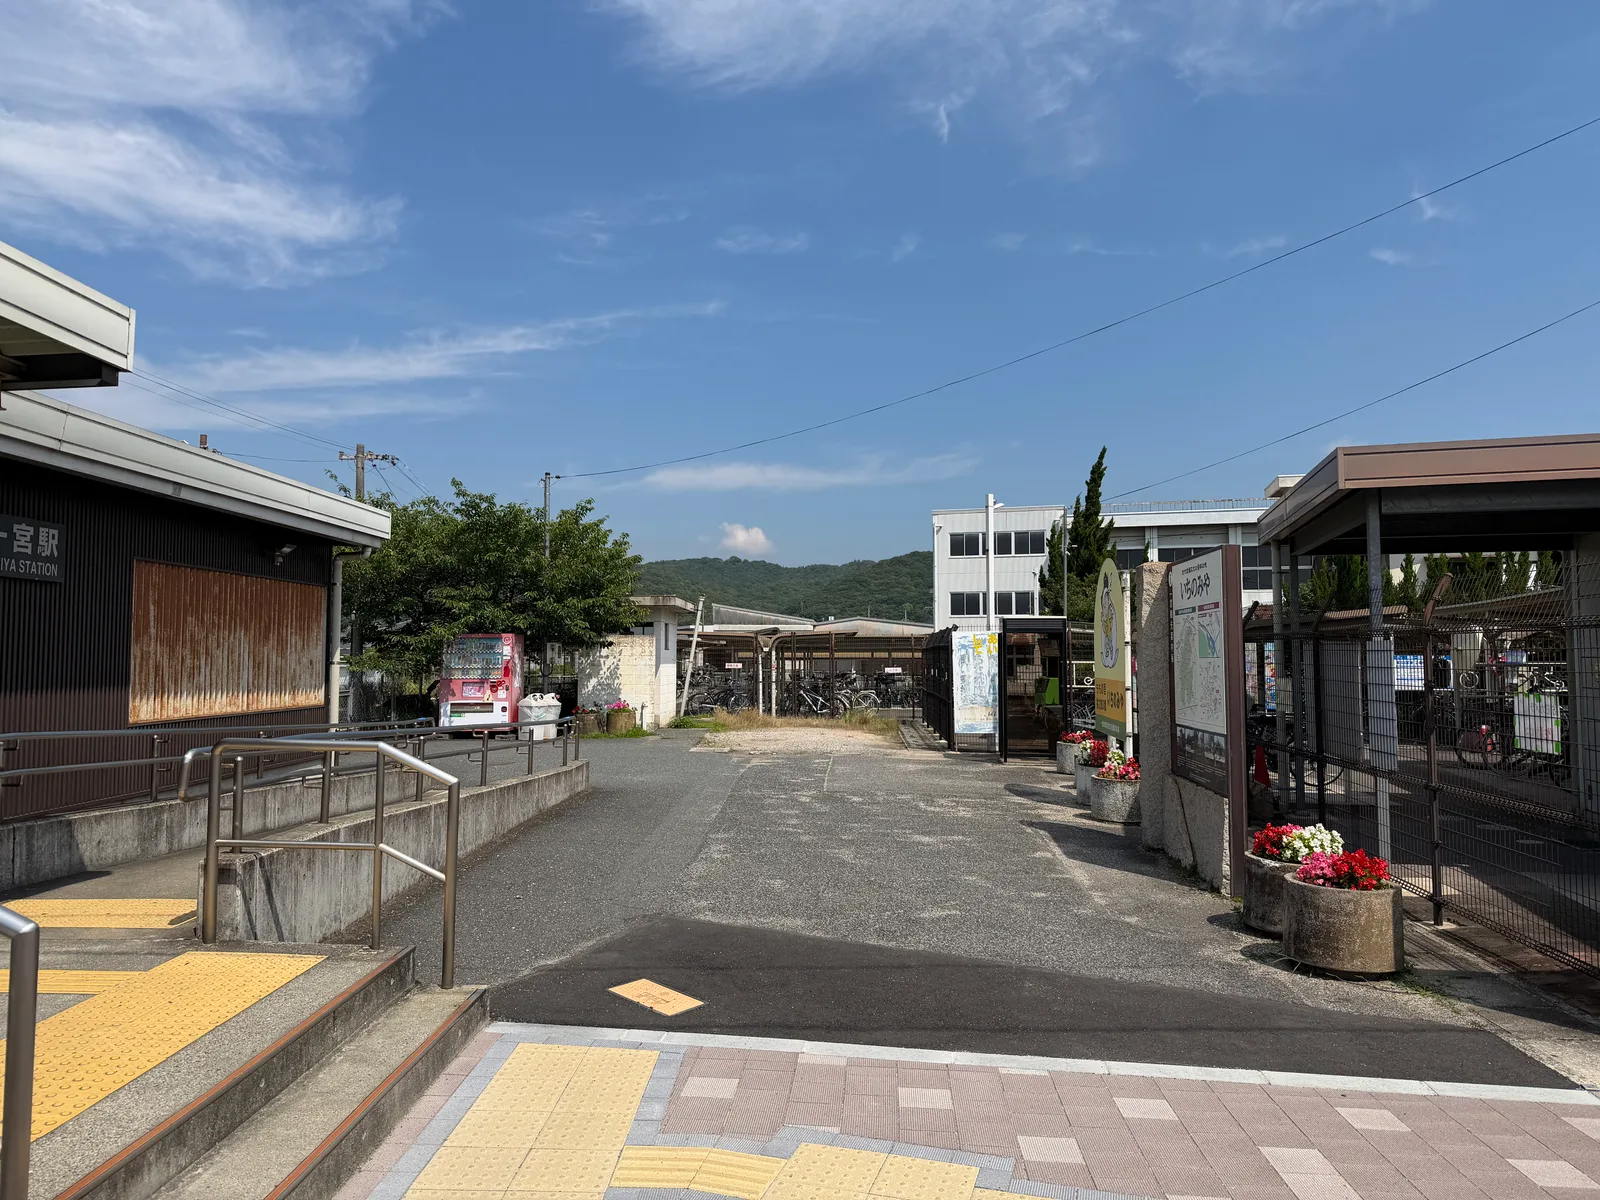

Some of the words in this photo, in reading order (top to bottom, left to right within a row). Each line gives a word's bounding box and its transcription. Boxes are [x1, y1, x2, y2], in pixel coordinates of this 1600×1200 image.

[18, 559, 58, 577] STATION
[1180, 572, 1211, 600] いちのみや
